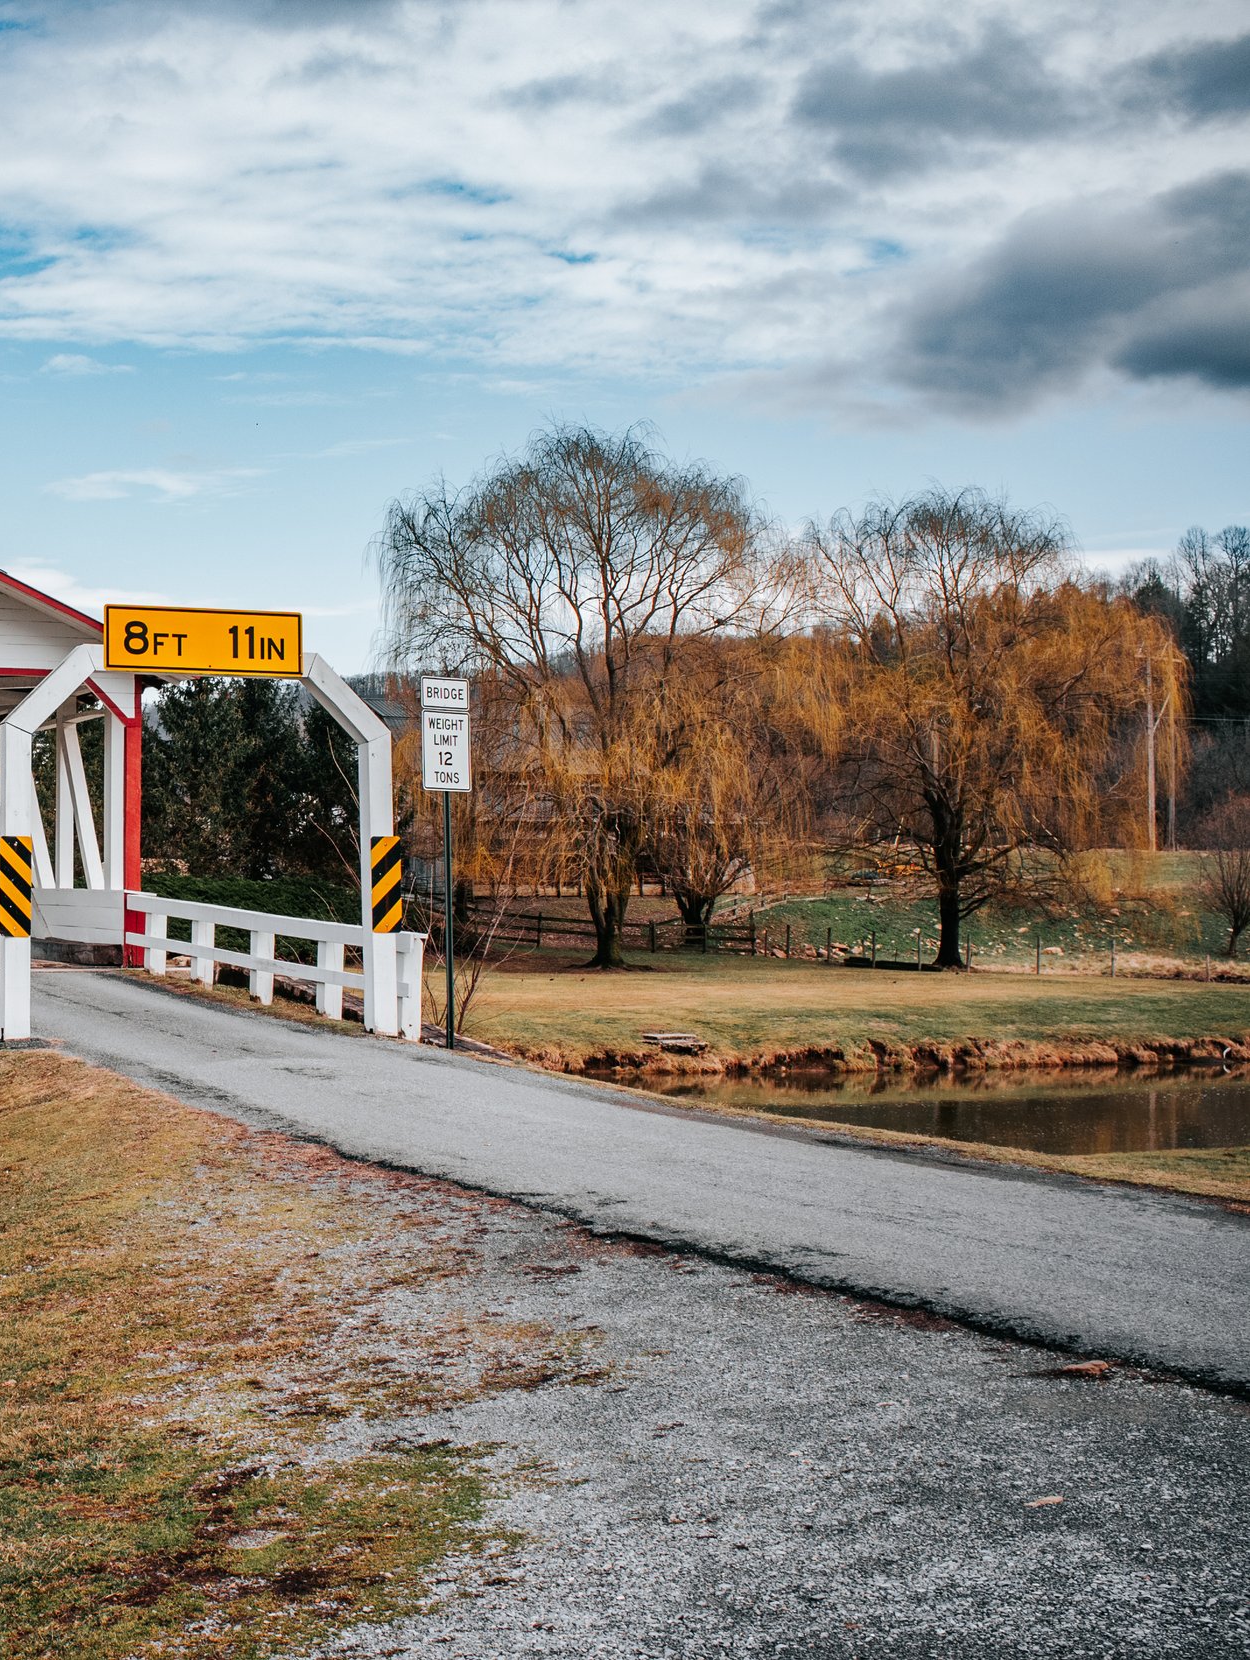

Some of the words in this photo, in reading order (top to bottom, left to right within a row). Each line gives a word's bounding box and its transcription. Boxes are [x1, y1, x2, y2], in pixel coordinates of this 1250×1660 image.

[426, 686, 464, 701] BRIDGE
[428, 717, 464, 731] WEIGHT
[433, 733, 459, 747] LIMIT
[438, 751, 453, 766] 12
[434, 770, 460, 784] TONS
